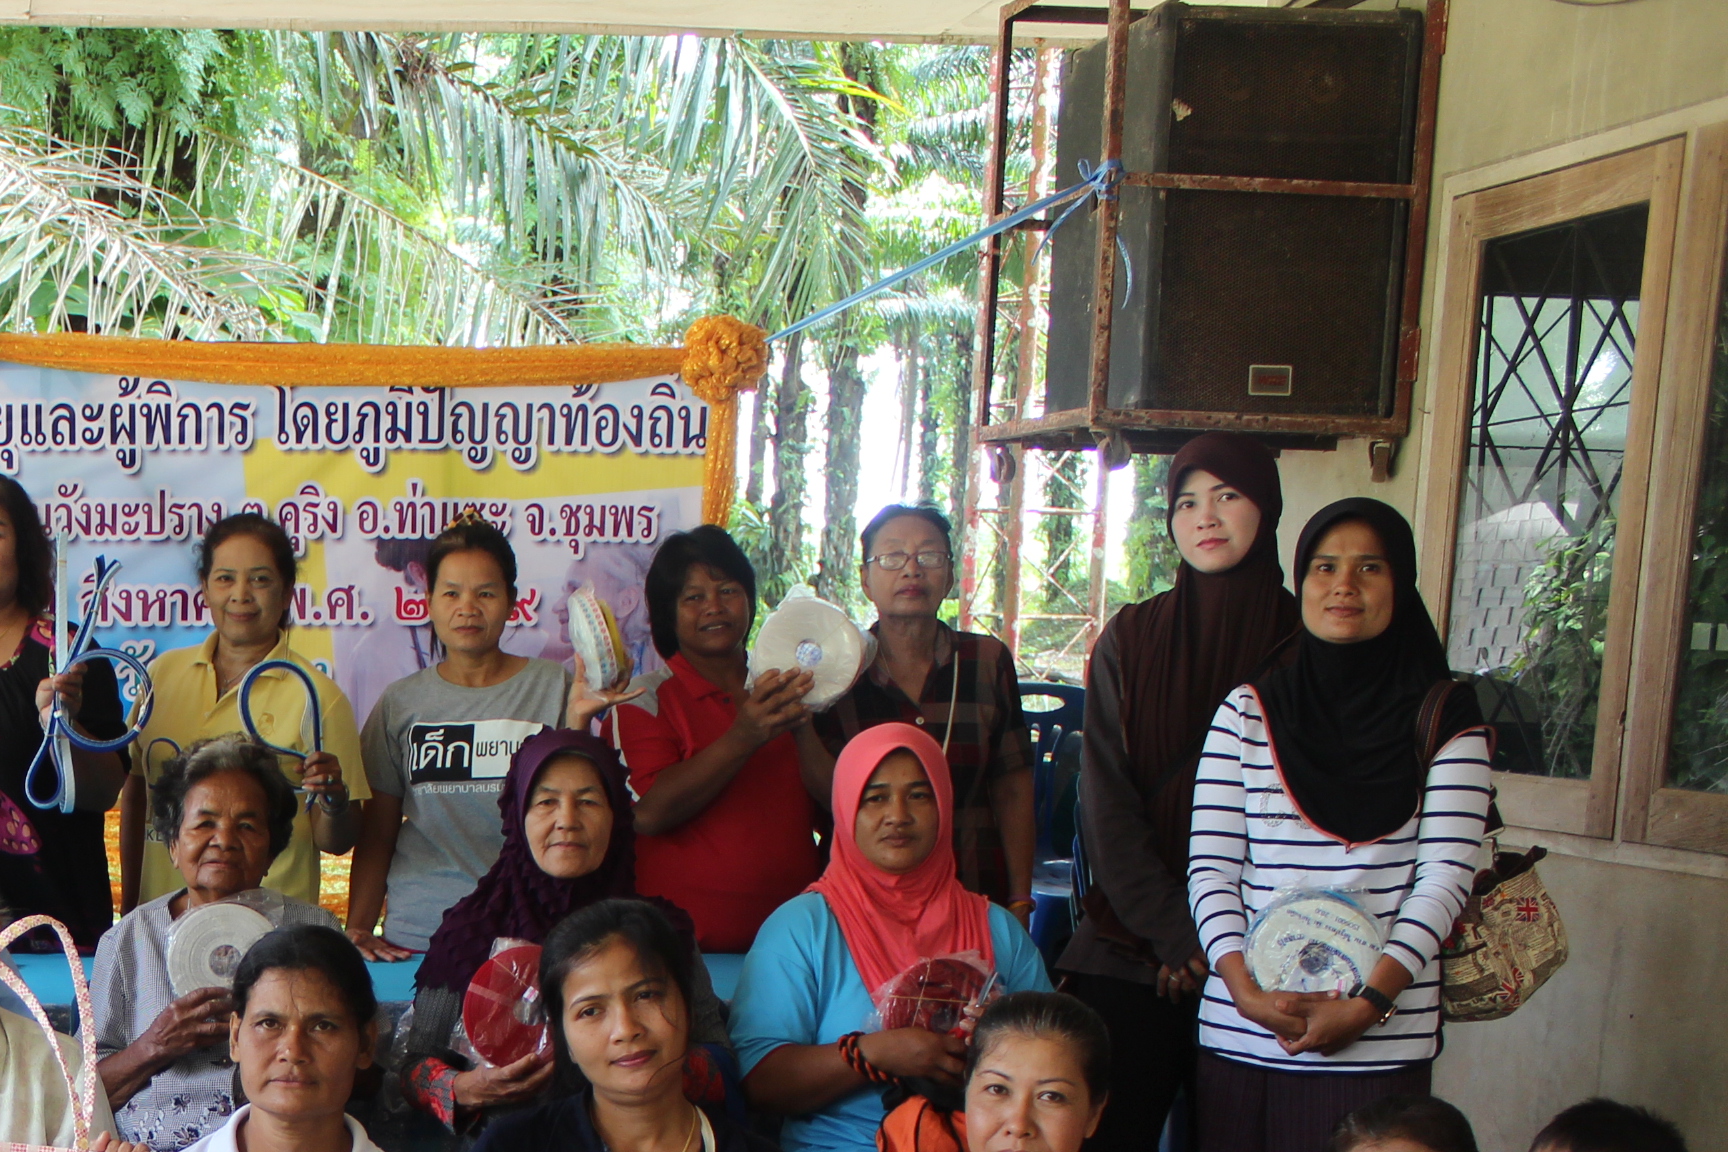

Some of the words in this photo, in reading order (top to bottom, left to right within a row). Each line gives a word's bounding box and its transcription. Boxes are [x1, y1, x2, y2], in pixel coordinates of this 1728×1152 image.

[273, 383, 707, 467] โดยภูมิปญญาท้องถิน
[525, 503, 657, 554] จ.ชุมพร
[411, 728, 471, 772] เด็ก
